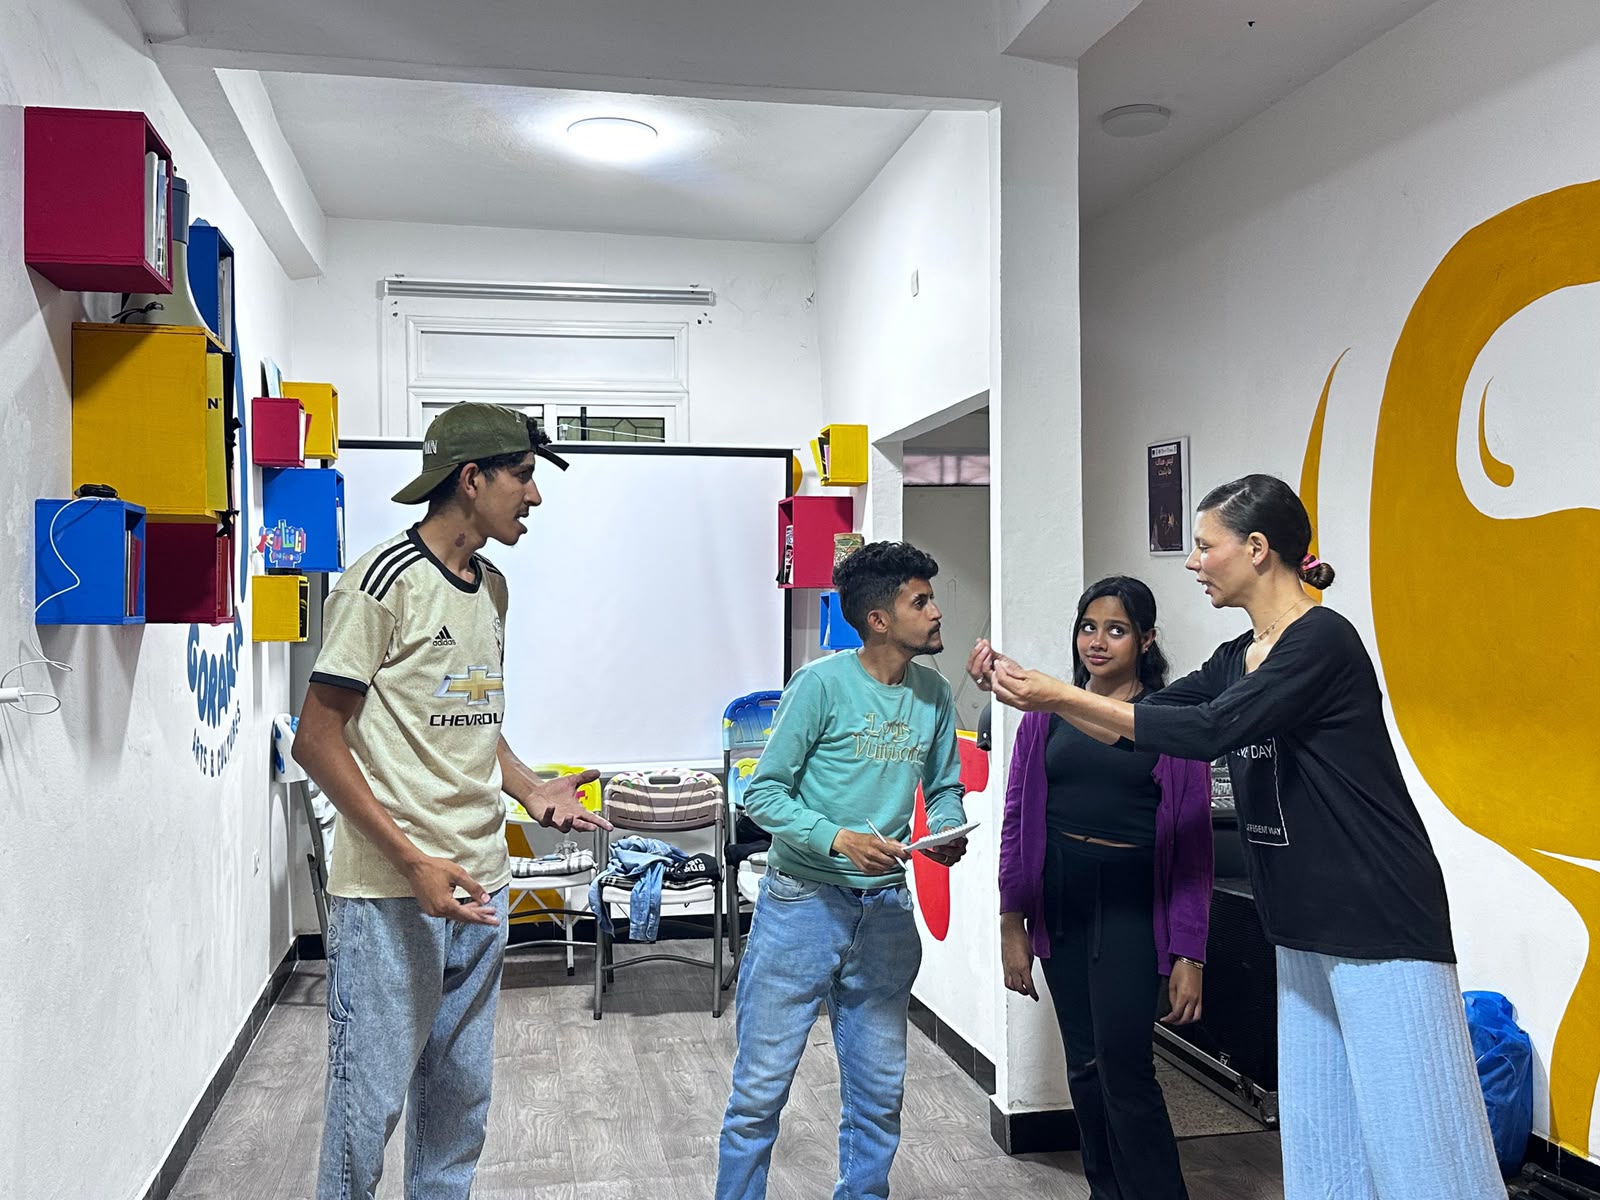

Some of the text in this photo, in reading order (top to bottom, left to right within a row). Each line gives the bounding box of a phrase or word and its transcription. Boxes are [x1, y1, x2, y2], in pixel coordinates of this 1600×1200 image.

[432, 639, 456, 647] adidas
[429, 712, 504, 727] CHEVROL
[192, 728, 207, 775] ARTS
[217, 700, 241, 777] CULTURES
[1250, 744, 1272, 759] DAY
[1268, 826, 1281, 836] WAY
